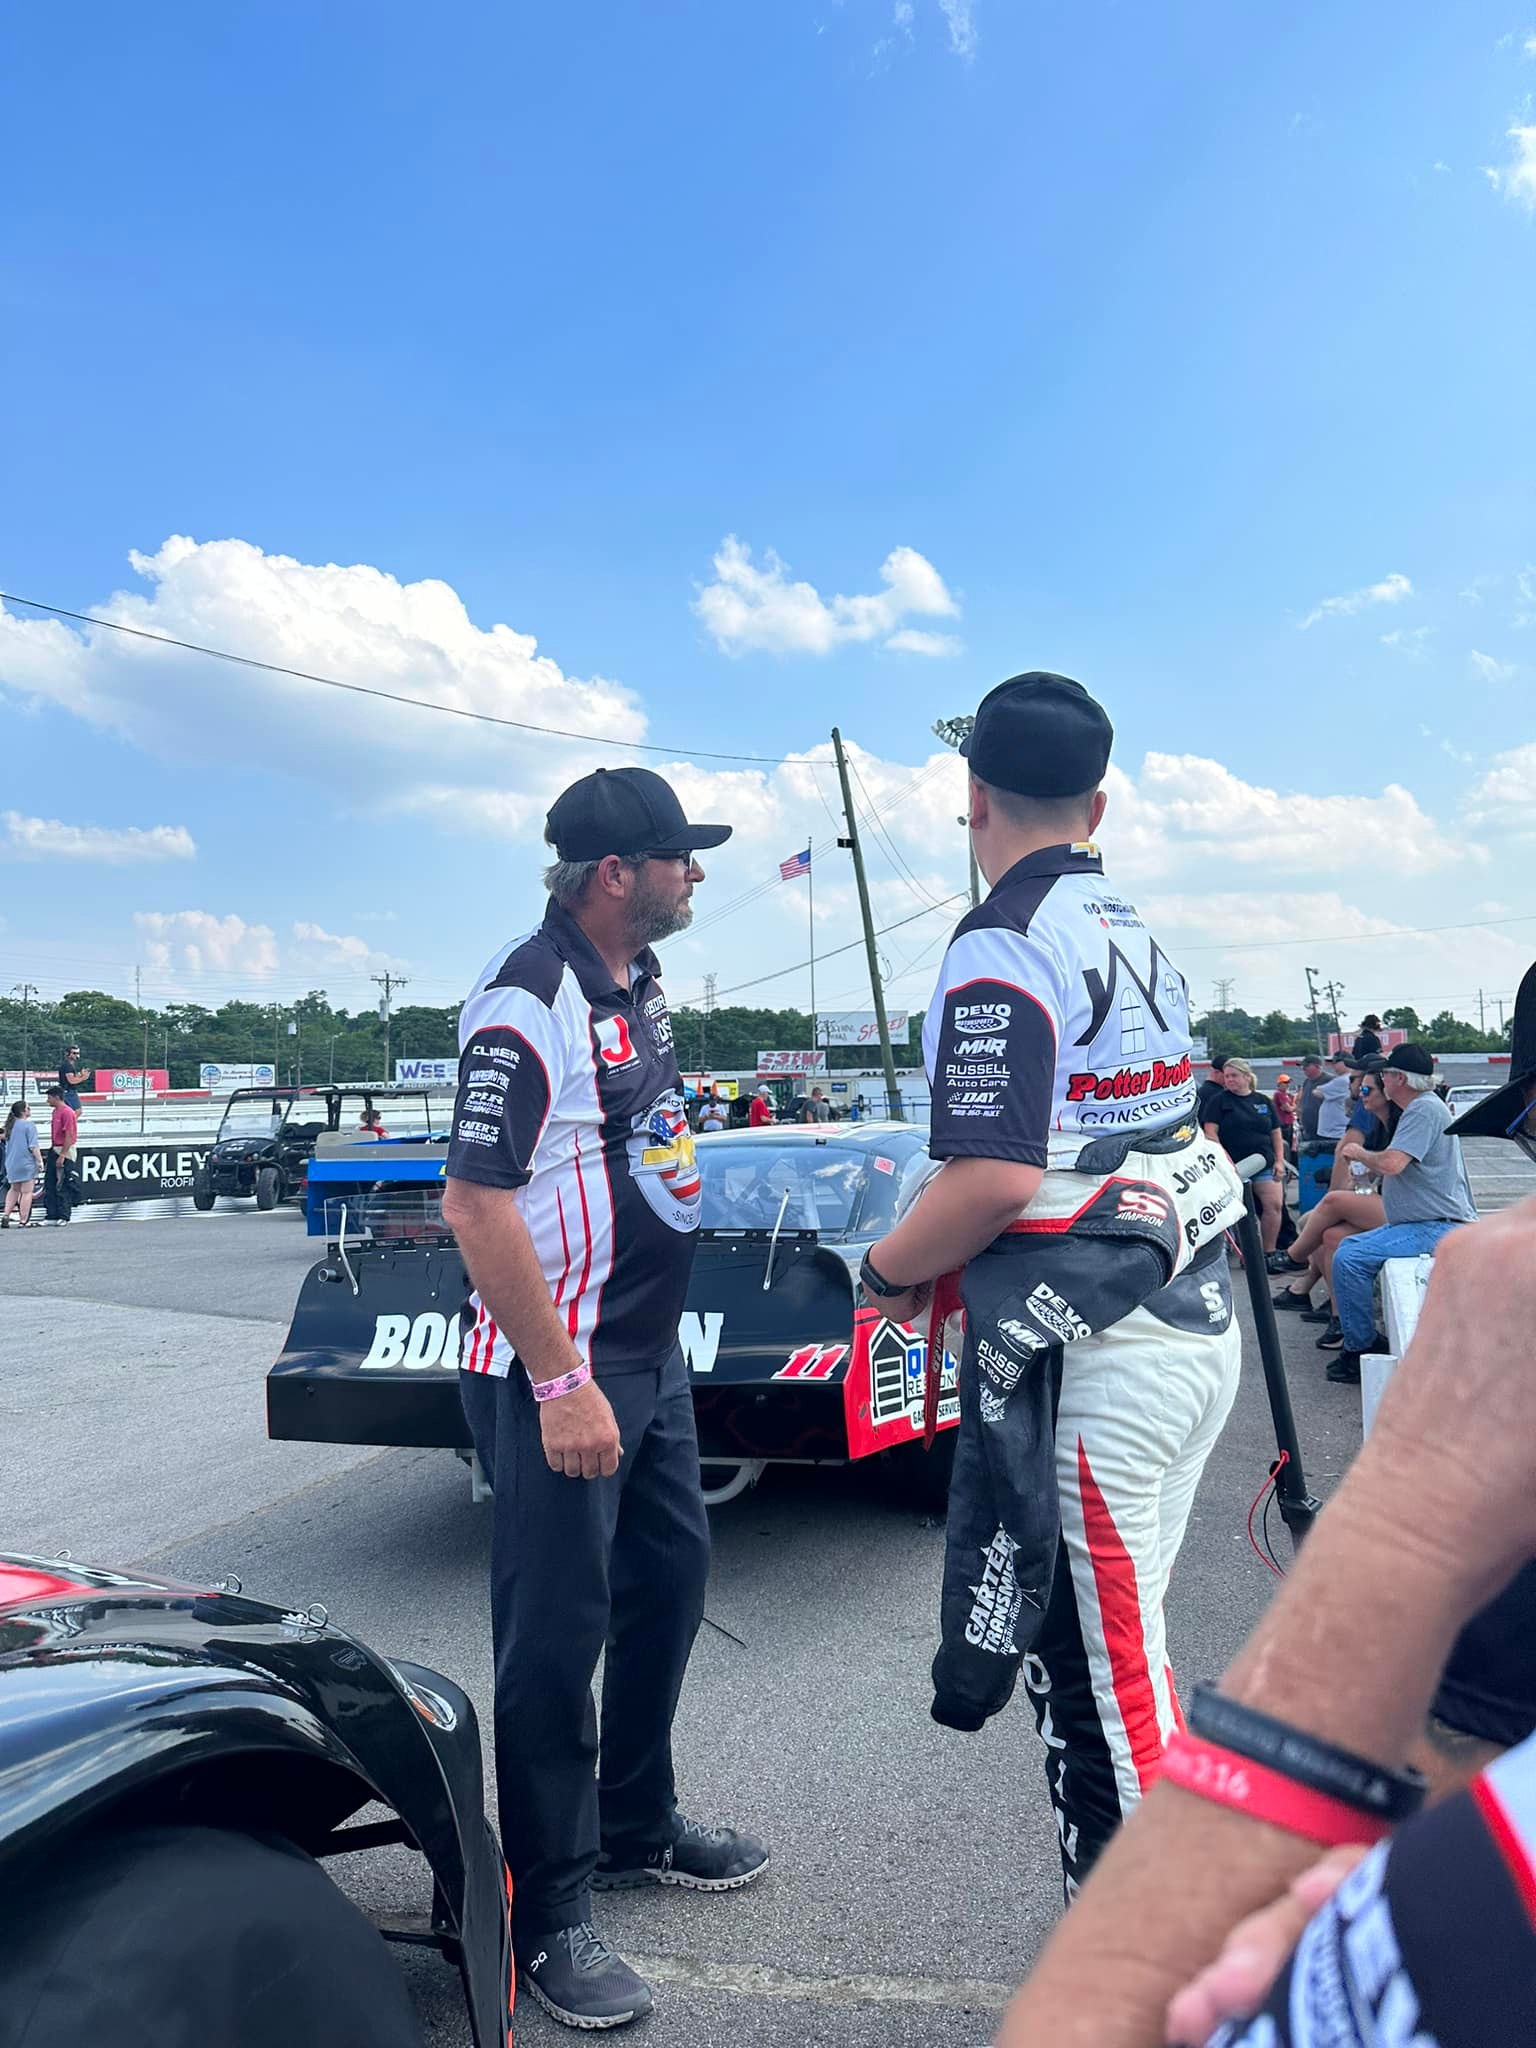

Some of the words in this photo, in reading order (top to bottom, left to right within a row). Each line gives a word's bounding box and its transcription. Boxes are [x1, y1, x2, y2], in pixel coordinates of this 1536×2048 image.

[955, 1004, 1011, 1021] DEVO
[857, 1016, 906, 1042] SPED
[958, 1039, 1008, 1057] MHR
[400, 1062, 446, 1079] WSE
[946, 1063, 1011, 1075] RUSSELL
[115, 1072, 153, 1089] O'Reily
[947, 1079, 978, 1088] Auto
[980, 1079, 1008, 1088] Care
[1066, 1067, 1151, 1101] Potter
[961, 1092, 1000, 1103] DAY
[1081, 1088, 1196, 1125] CONSTRUCT
[82, 1151, 210, 1182] RACKLEY
[1114, 1211, 1164, 1228] SIMPSON
[1031, 1282, 1092, 1339] DEVO
[771, 1343, 850, 1381] 11
